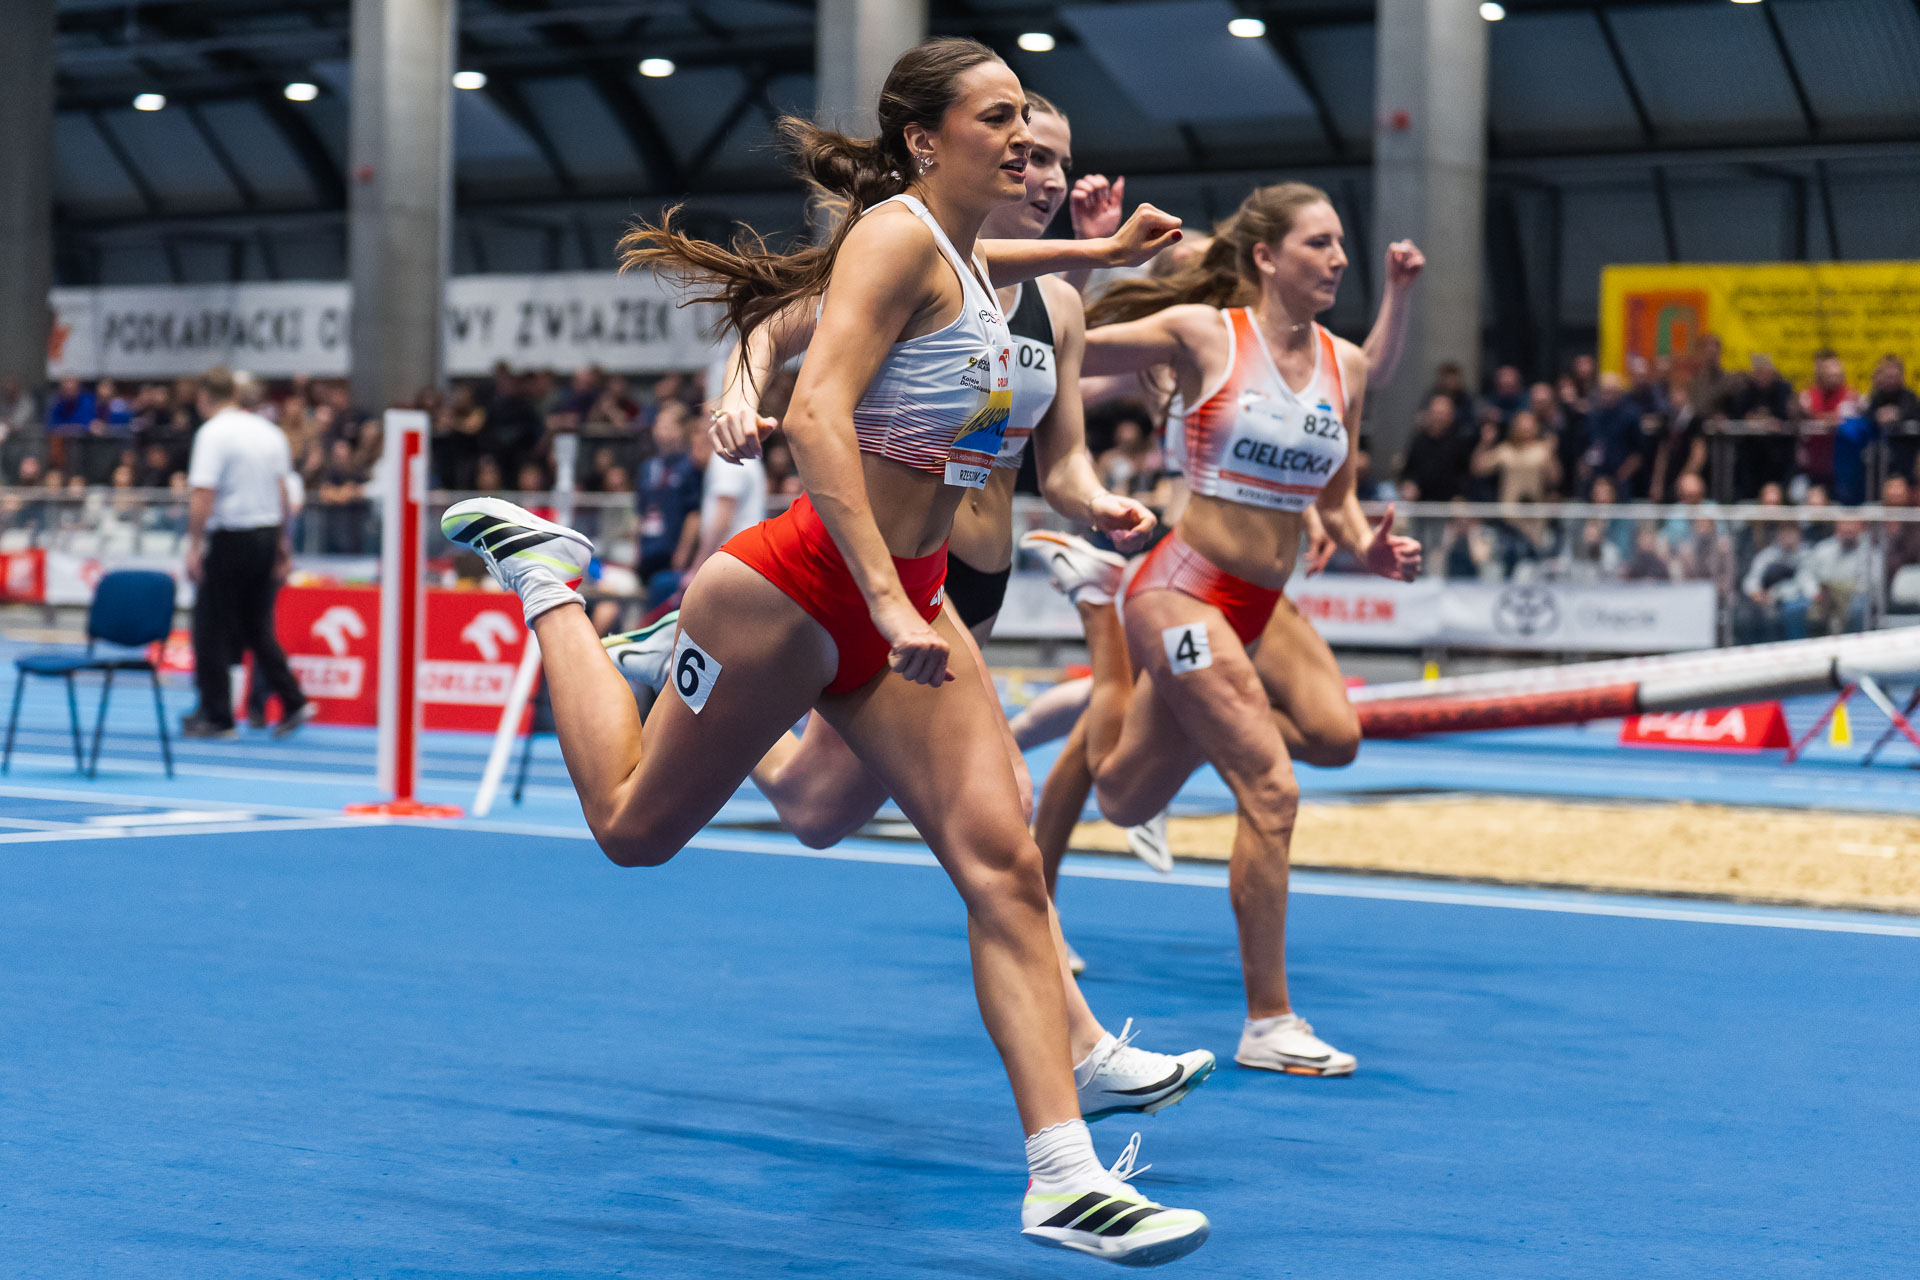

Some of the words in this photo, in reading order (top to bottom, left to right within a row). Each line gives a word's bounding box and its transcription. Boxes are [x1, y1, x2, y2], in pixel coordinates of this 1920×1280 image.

[1303, 414, 1341, 441] 822
[1233, 438, 1333, 475] CIELECKA
[1175, 629, 1200, 665] 4
[676, 647, 706, 697] 6
